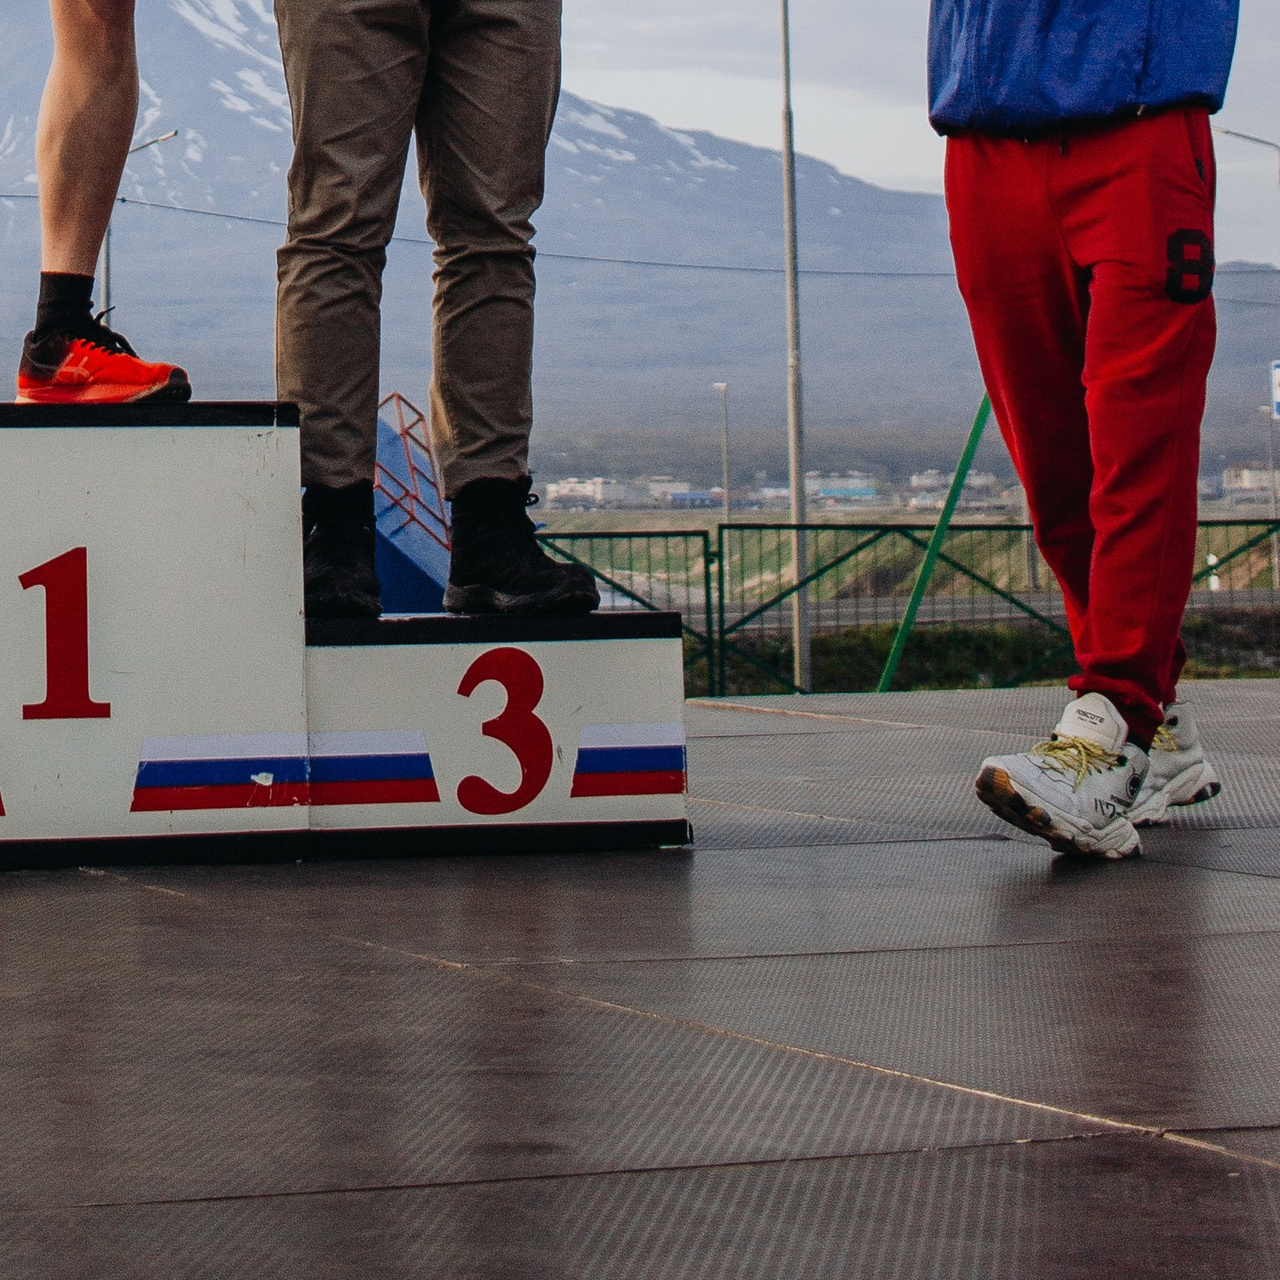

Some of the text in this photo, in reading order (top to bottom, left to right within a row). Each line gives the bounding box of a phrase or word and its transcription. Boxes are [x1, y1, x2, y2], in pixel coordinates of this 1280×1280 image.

[1166, 228, 1214, 305] 8
[18, 546, 111, 720] 1
[456, 647, 554, 816] 3
